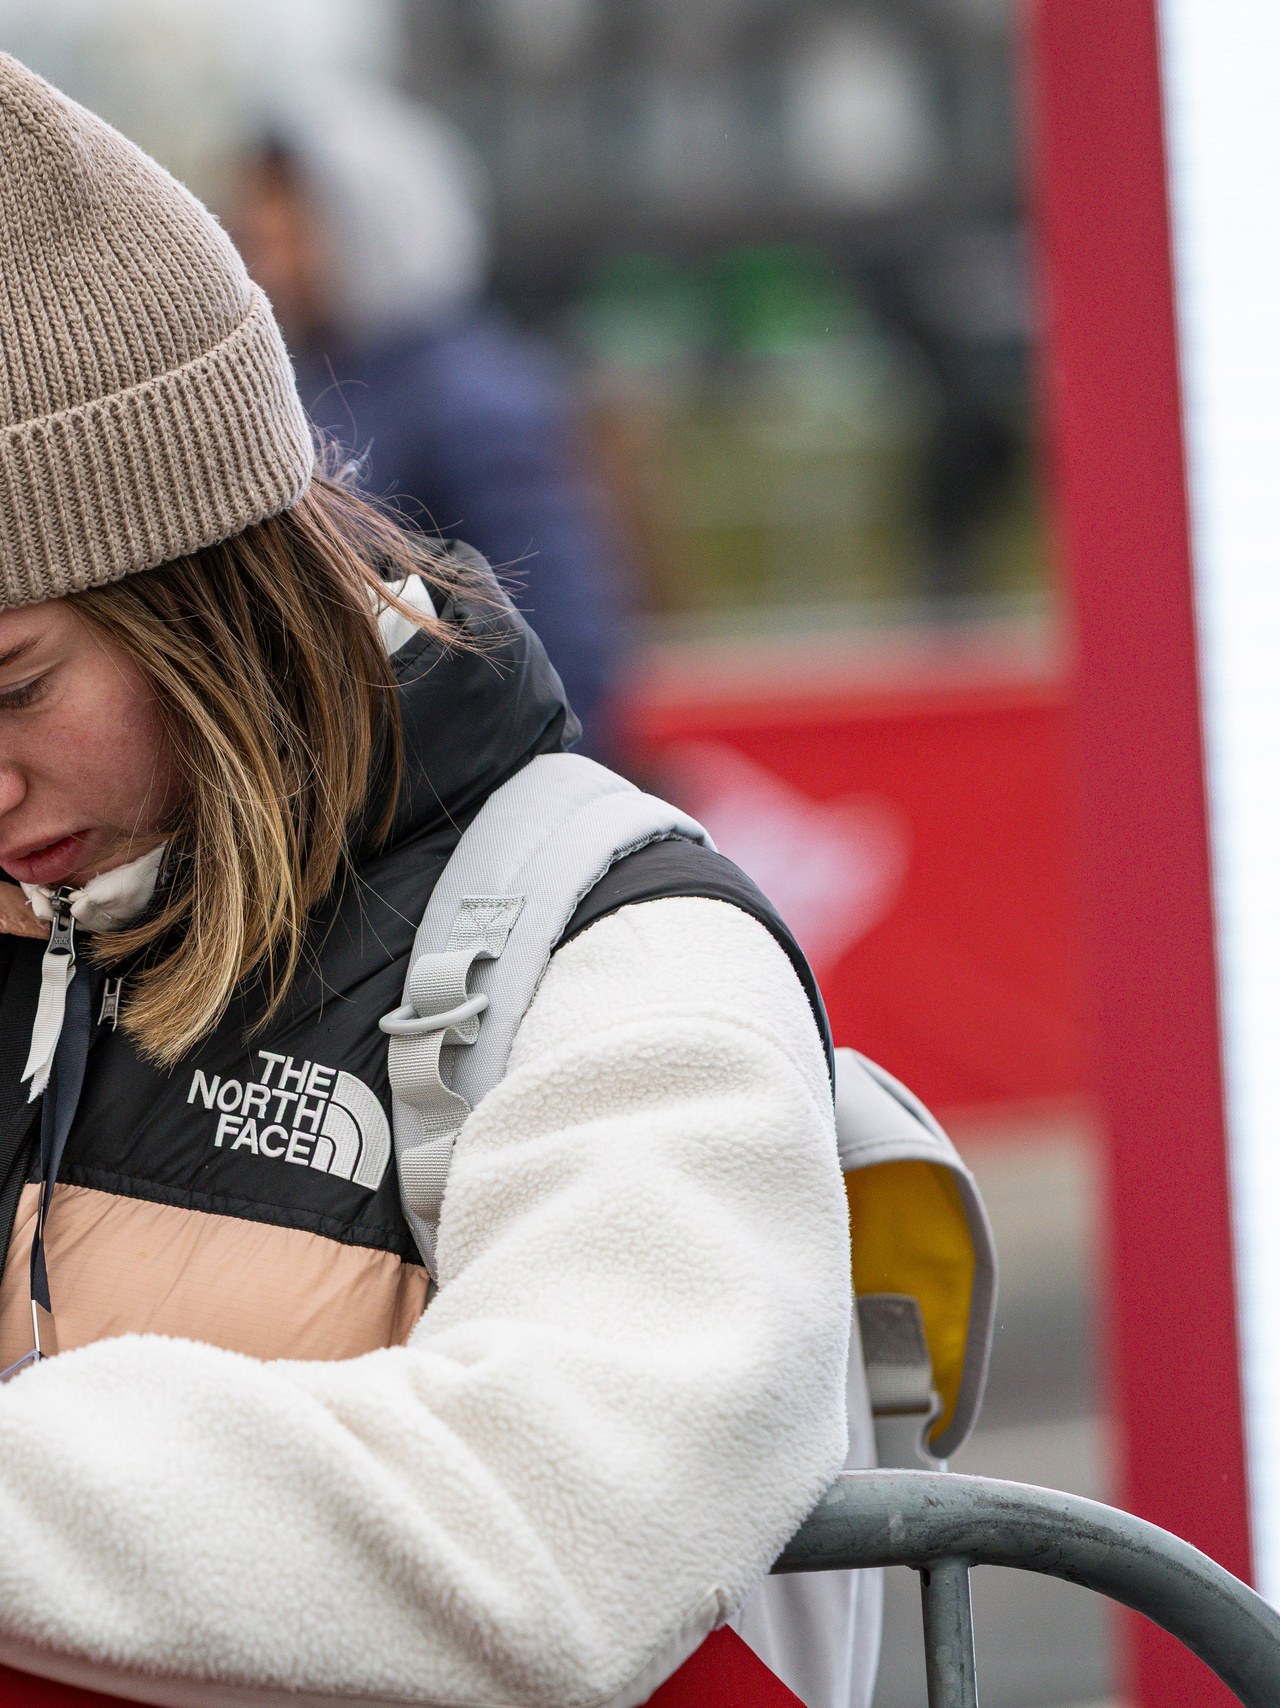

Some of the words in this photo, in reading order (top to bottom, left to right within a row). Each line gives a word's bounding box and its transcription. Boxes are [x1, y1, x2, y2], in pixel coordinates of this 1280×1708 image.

[187, 1068, 326, 1134] NORTH
[258, 1050, 336, 1099] THE
[214, 1112, 317, 1166] FACE
